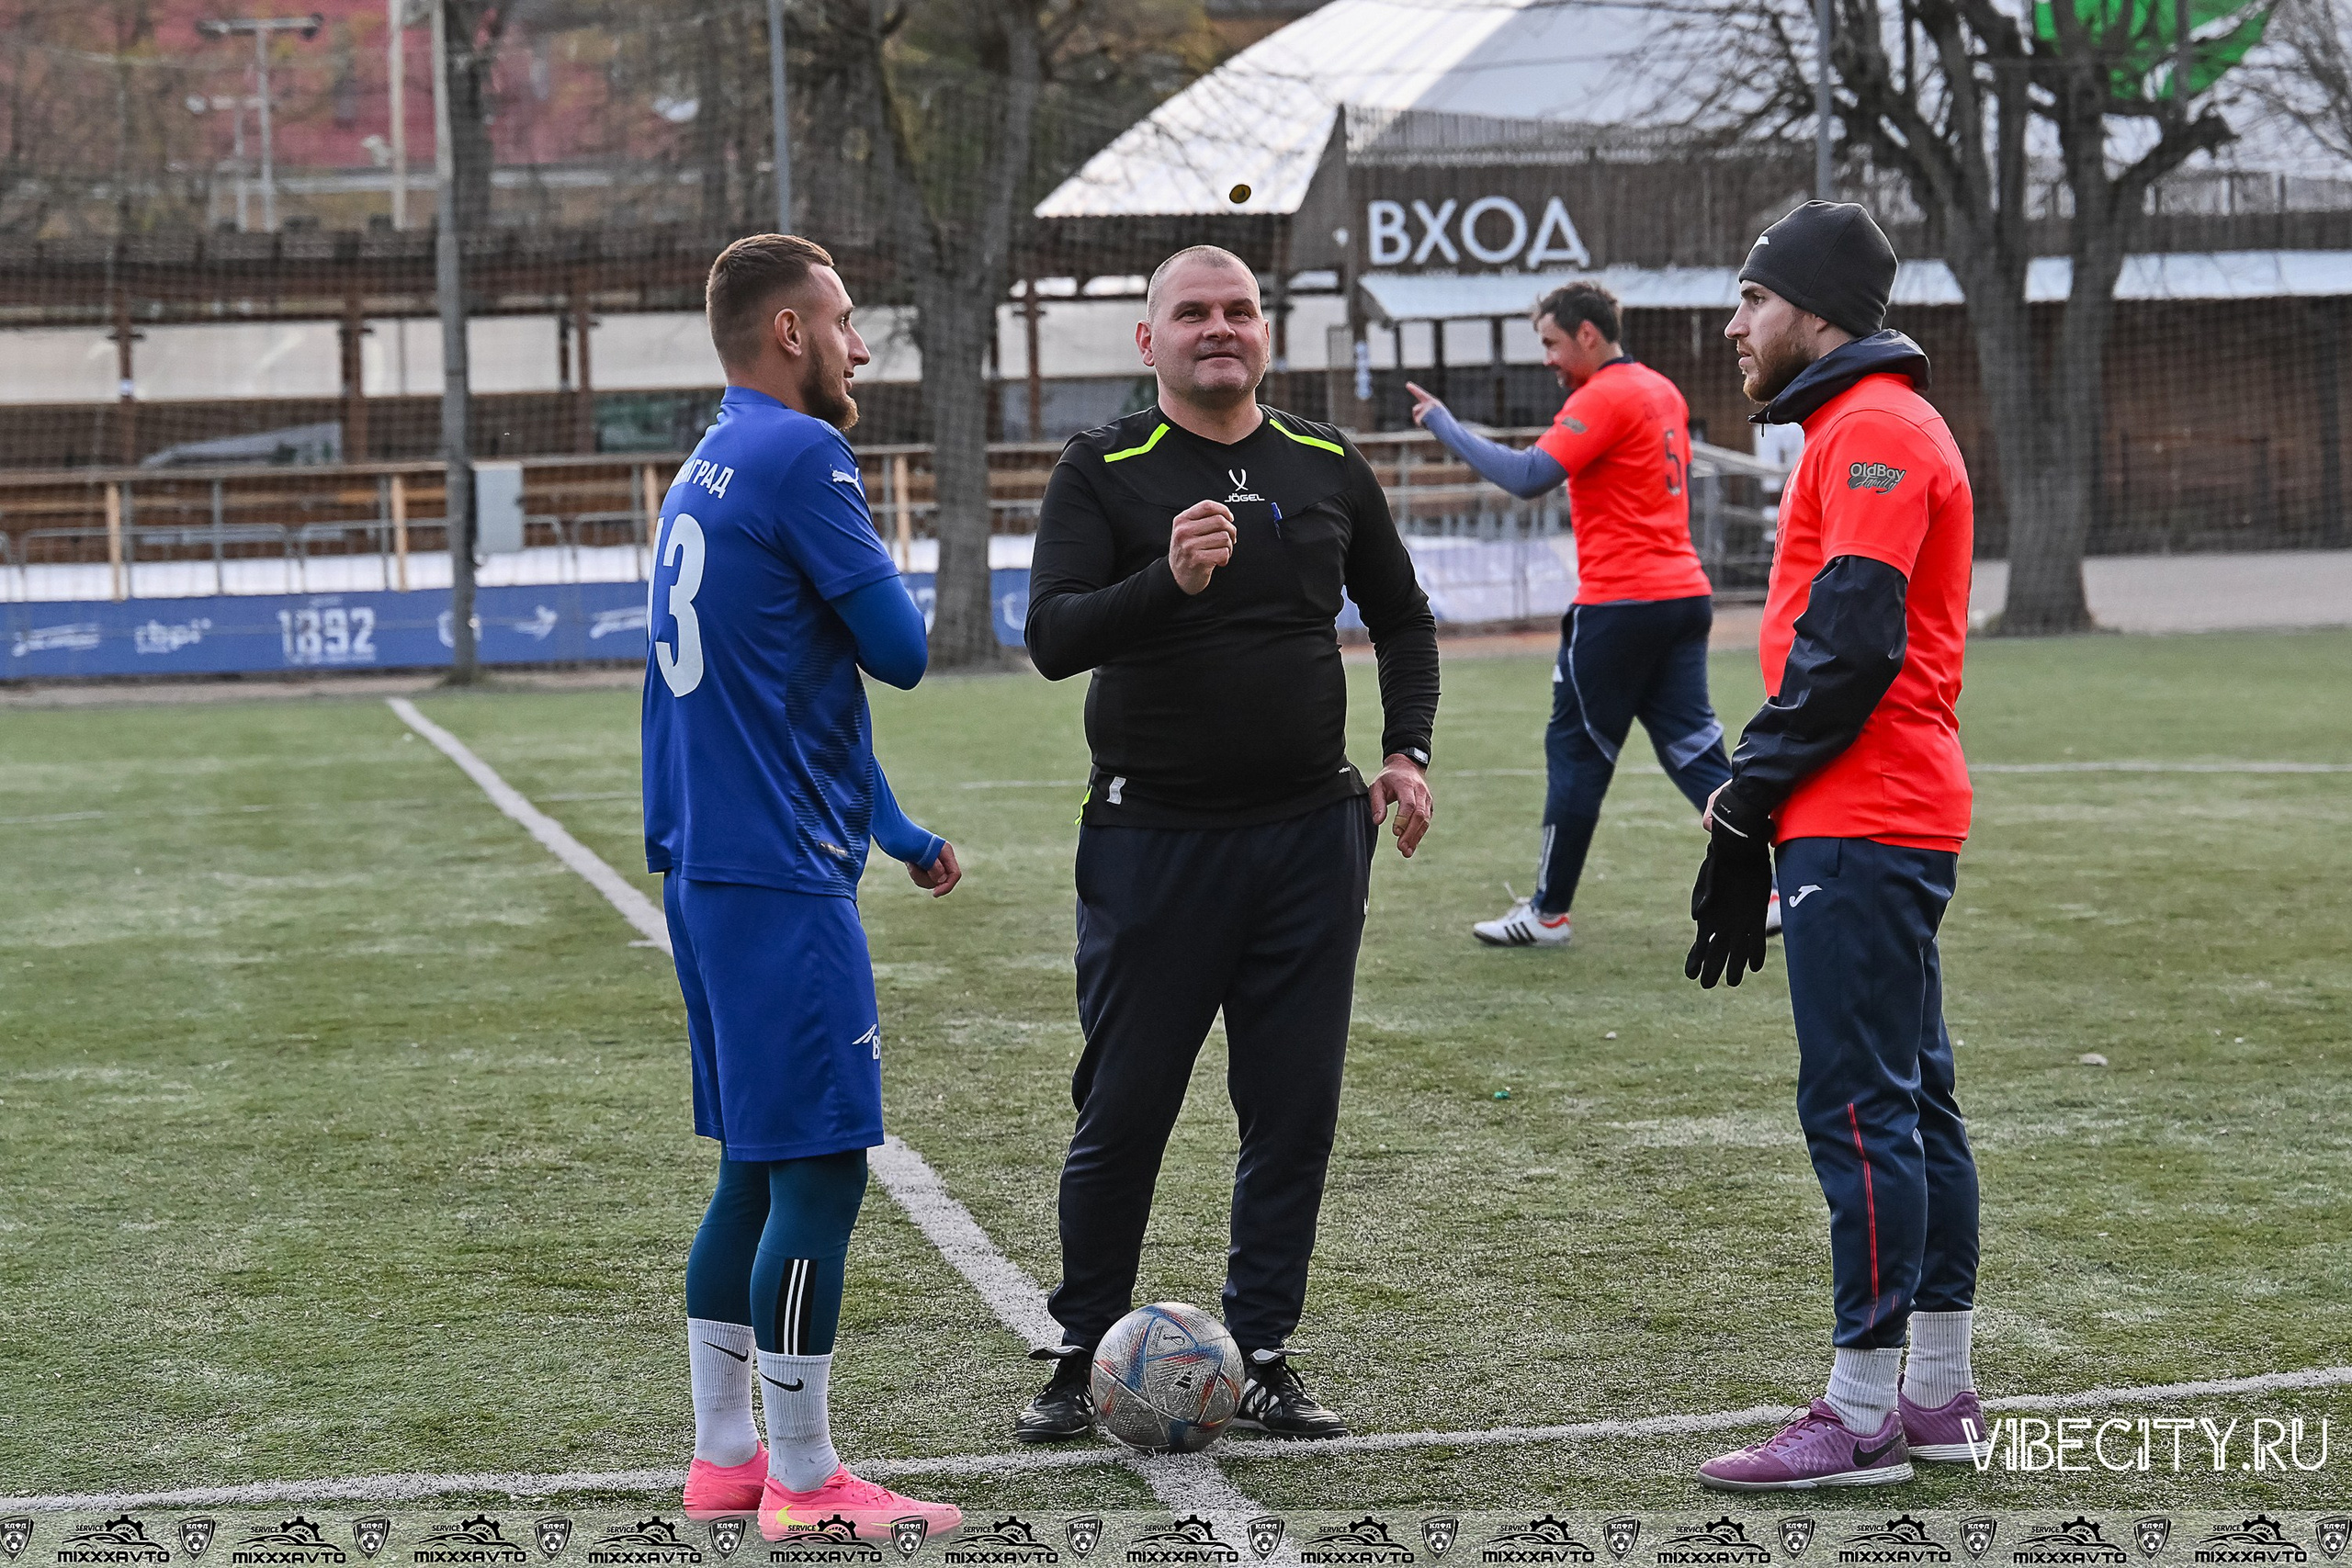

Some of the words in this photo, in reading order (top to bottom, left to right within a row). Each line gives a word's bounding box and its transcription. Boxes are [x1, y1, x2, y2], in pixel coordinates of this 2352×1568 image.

[1368, 196, 1590, 269] ВХОД
[1664, 429, 1682, 496] 5
[1849, 462, 1905, 483] OldBoy
[1224, 492, 1265, 502] JÖGEL
[278, 607, 377, 655] 1892
